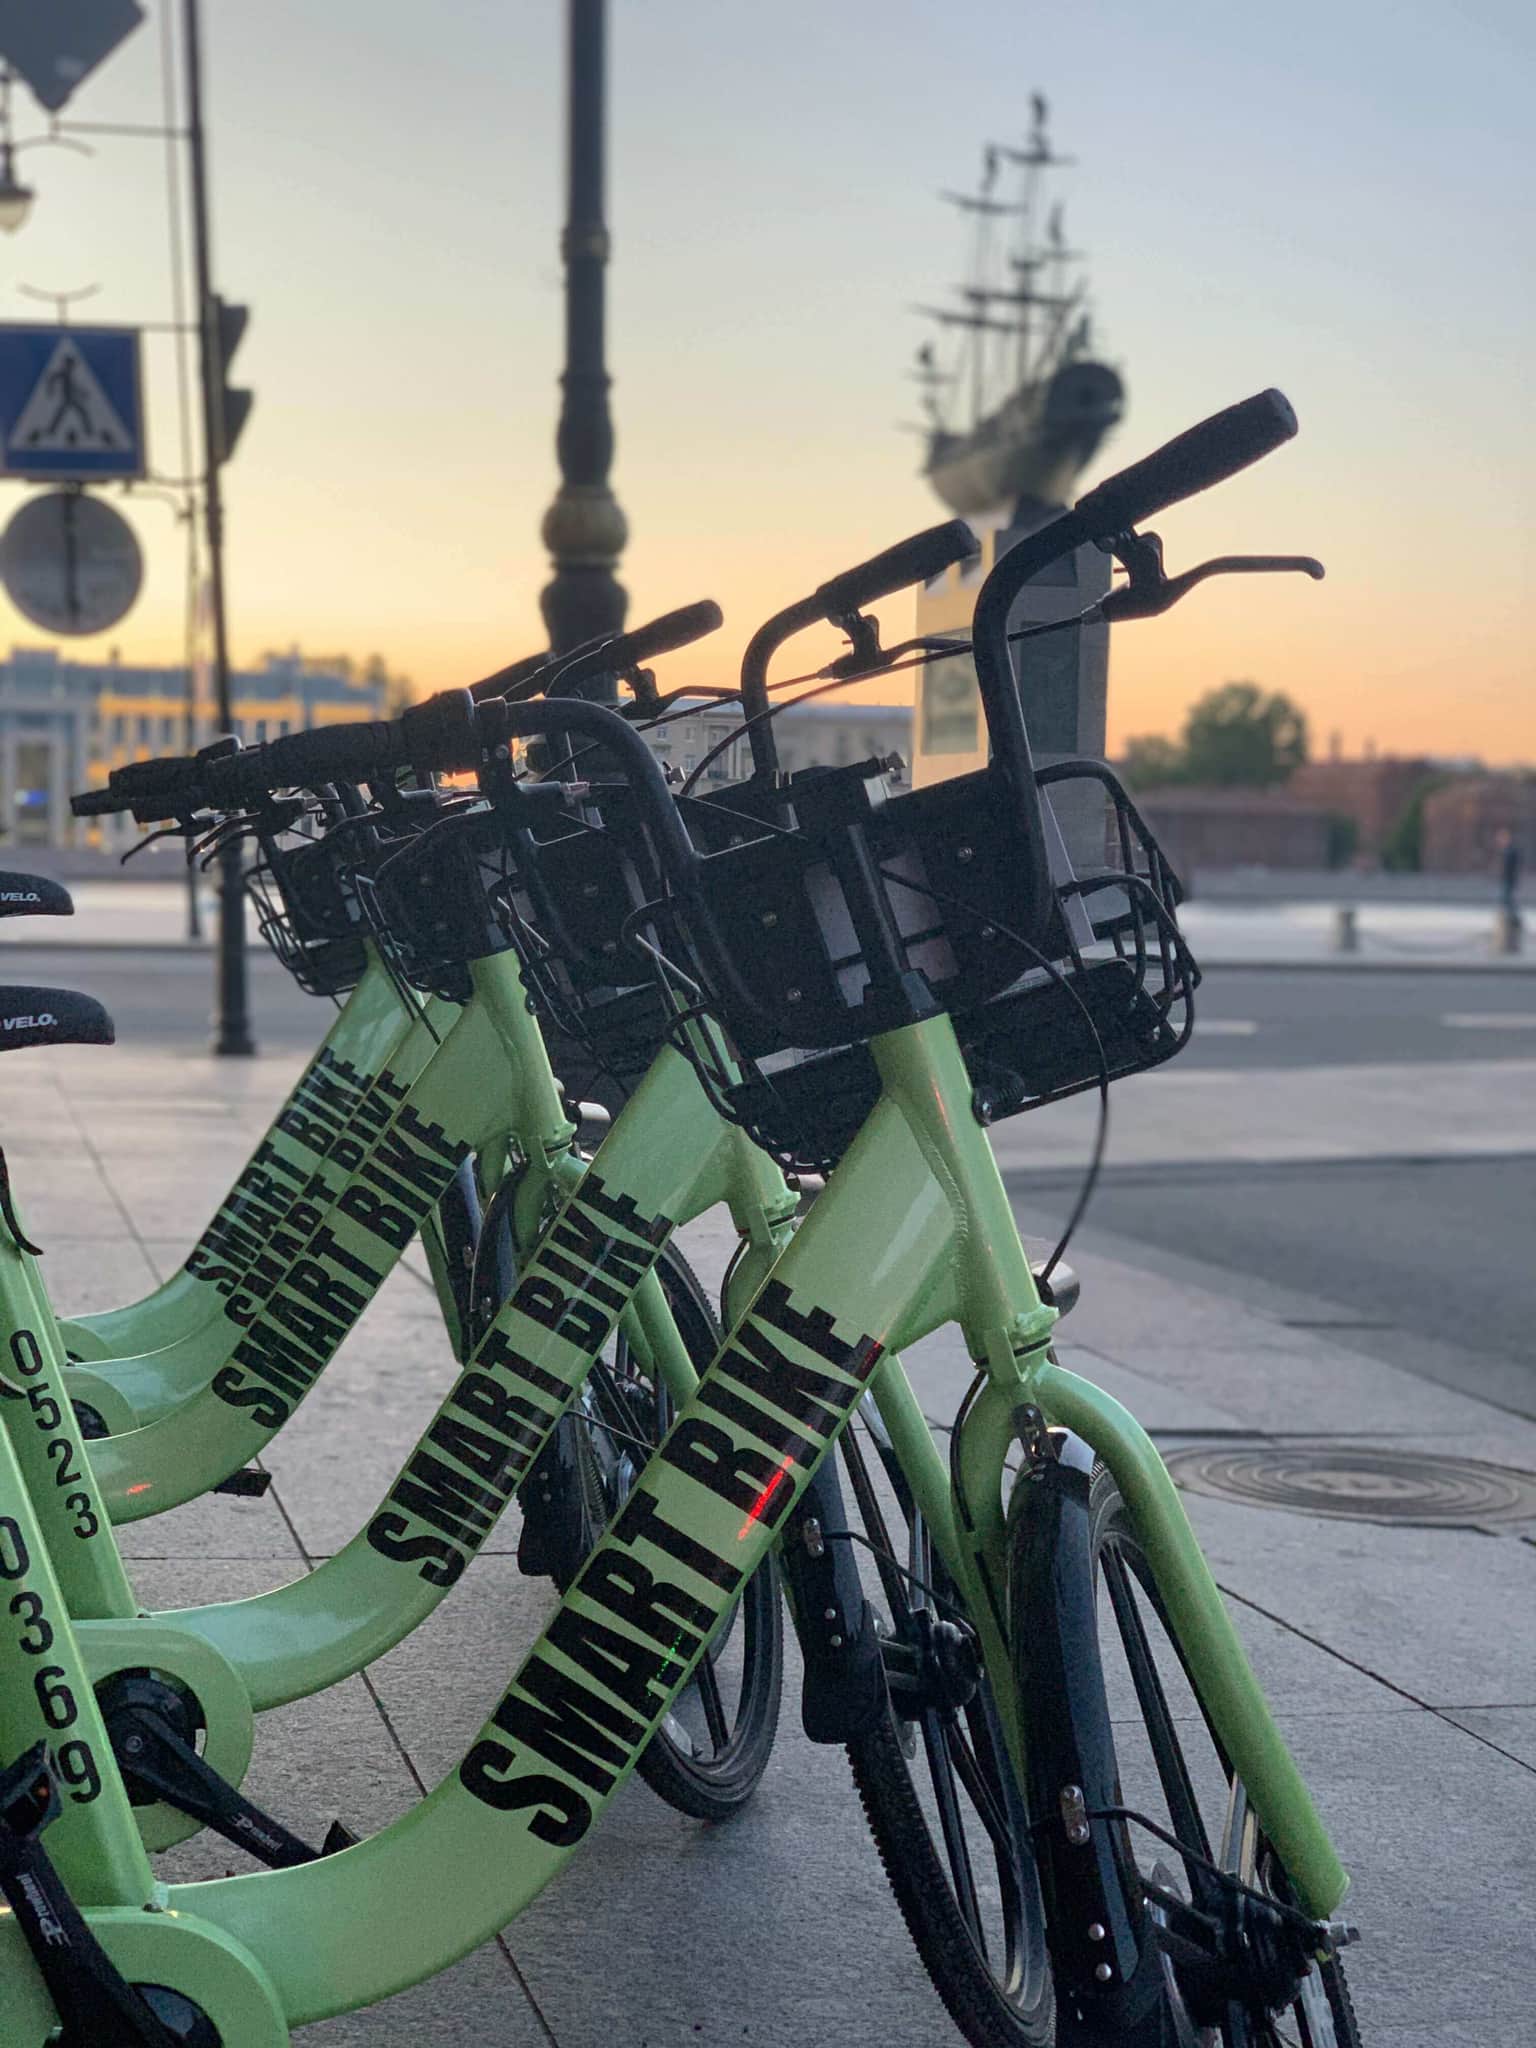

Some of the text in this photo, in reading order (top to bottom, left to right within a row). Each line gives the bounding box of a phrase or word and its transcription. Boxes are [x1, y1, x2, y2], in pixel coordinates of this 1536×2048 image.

[185, 1047, 376, 1298] SMART BIKE
[211, 1104, 474, 1429] SMART BIKE
[9, 1329, 99, 1539] 0523
[366, 1172, 675, 1588] SMART BIKE
[0, 1516, 102, 1804] 0369
[460, 1278, 887, 1848] SMART BIKE
